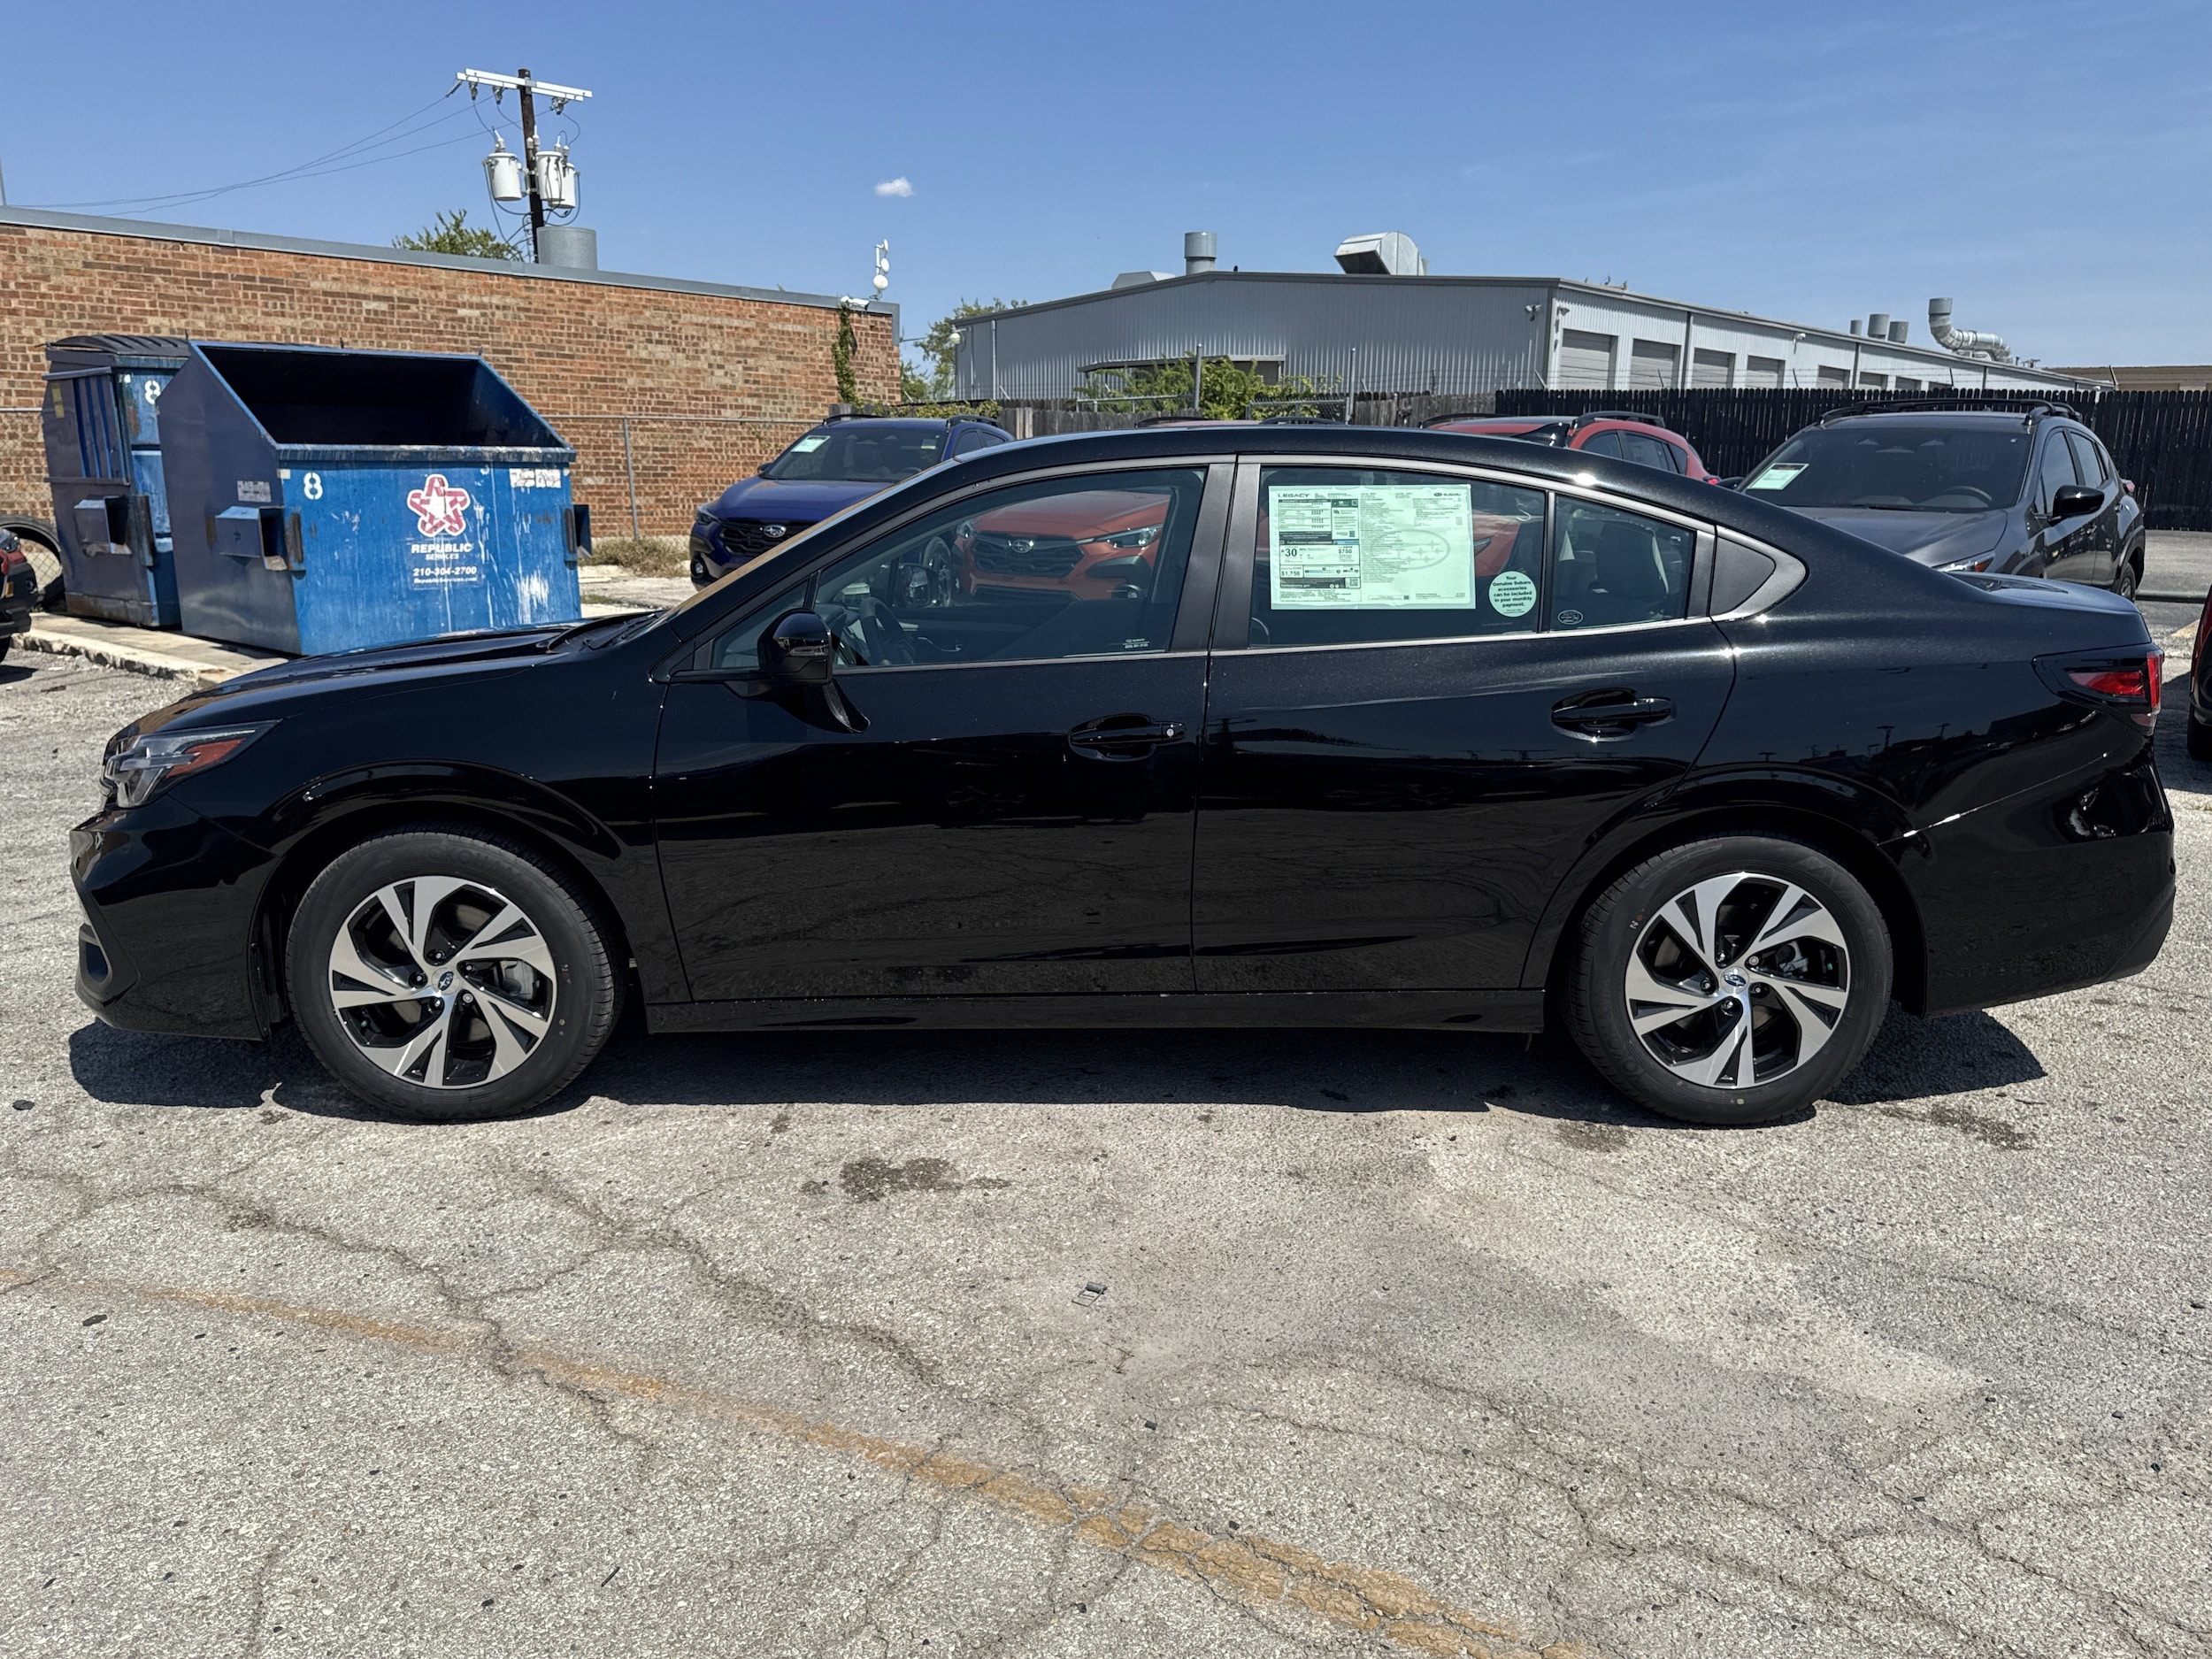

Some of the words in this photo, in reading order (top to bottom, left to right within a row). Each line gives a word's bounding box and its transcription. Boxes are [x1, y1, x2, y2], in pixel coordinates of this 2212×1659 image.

[144, 380, 161, 404] 8
[303, 472, 323, 500] 8
[411, 543, 473, 554] REPUBLIC
[1285, 548, 1297, 557] 30
[412, 566, 477, 577] 210-304-2700
